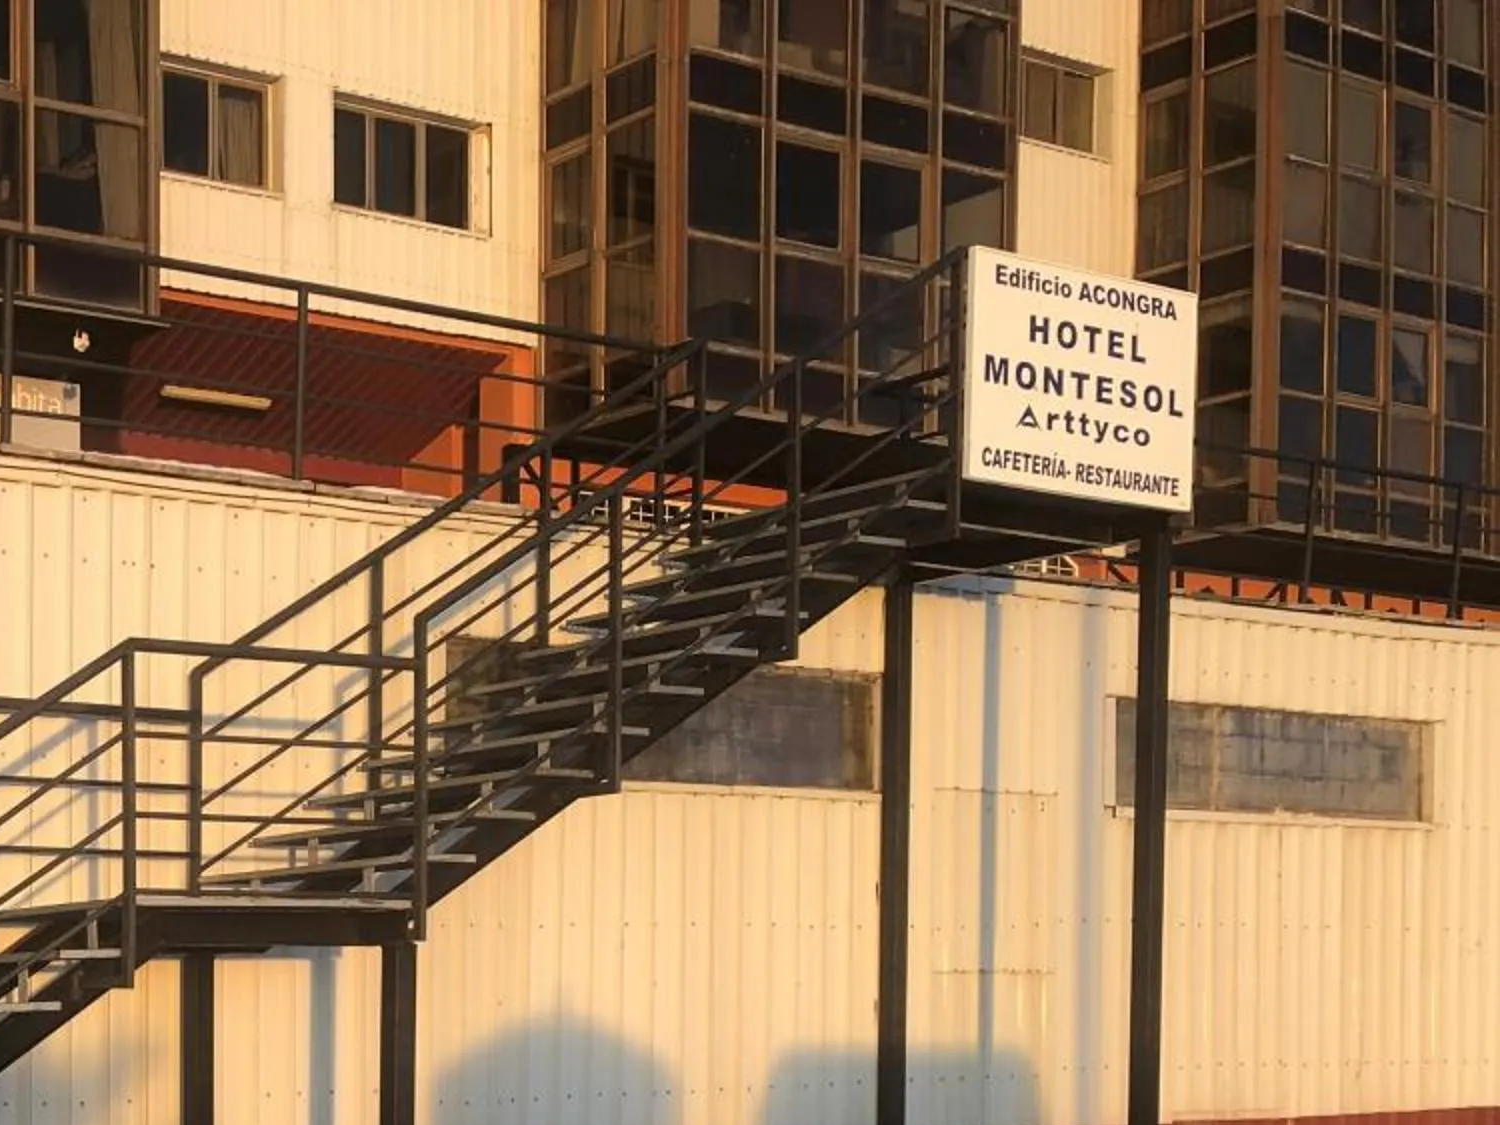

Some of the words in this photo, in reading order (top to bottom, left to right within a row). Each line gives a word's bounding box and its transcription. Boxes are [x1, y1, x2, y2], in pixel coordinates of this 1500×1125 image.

[995, 263, 1072, 299] Edificio
[1078, 282, 1178, 321] ACONGRA
[1029, 314, 1146, 364] HOTEL
[984, 354, 1184, 418] MONTESOL
[1016, 403, 1151, 447] Arttyco
[1075, 463, 1179, 497] RESTAURANTE
